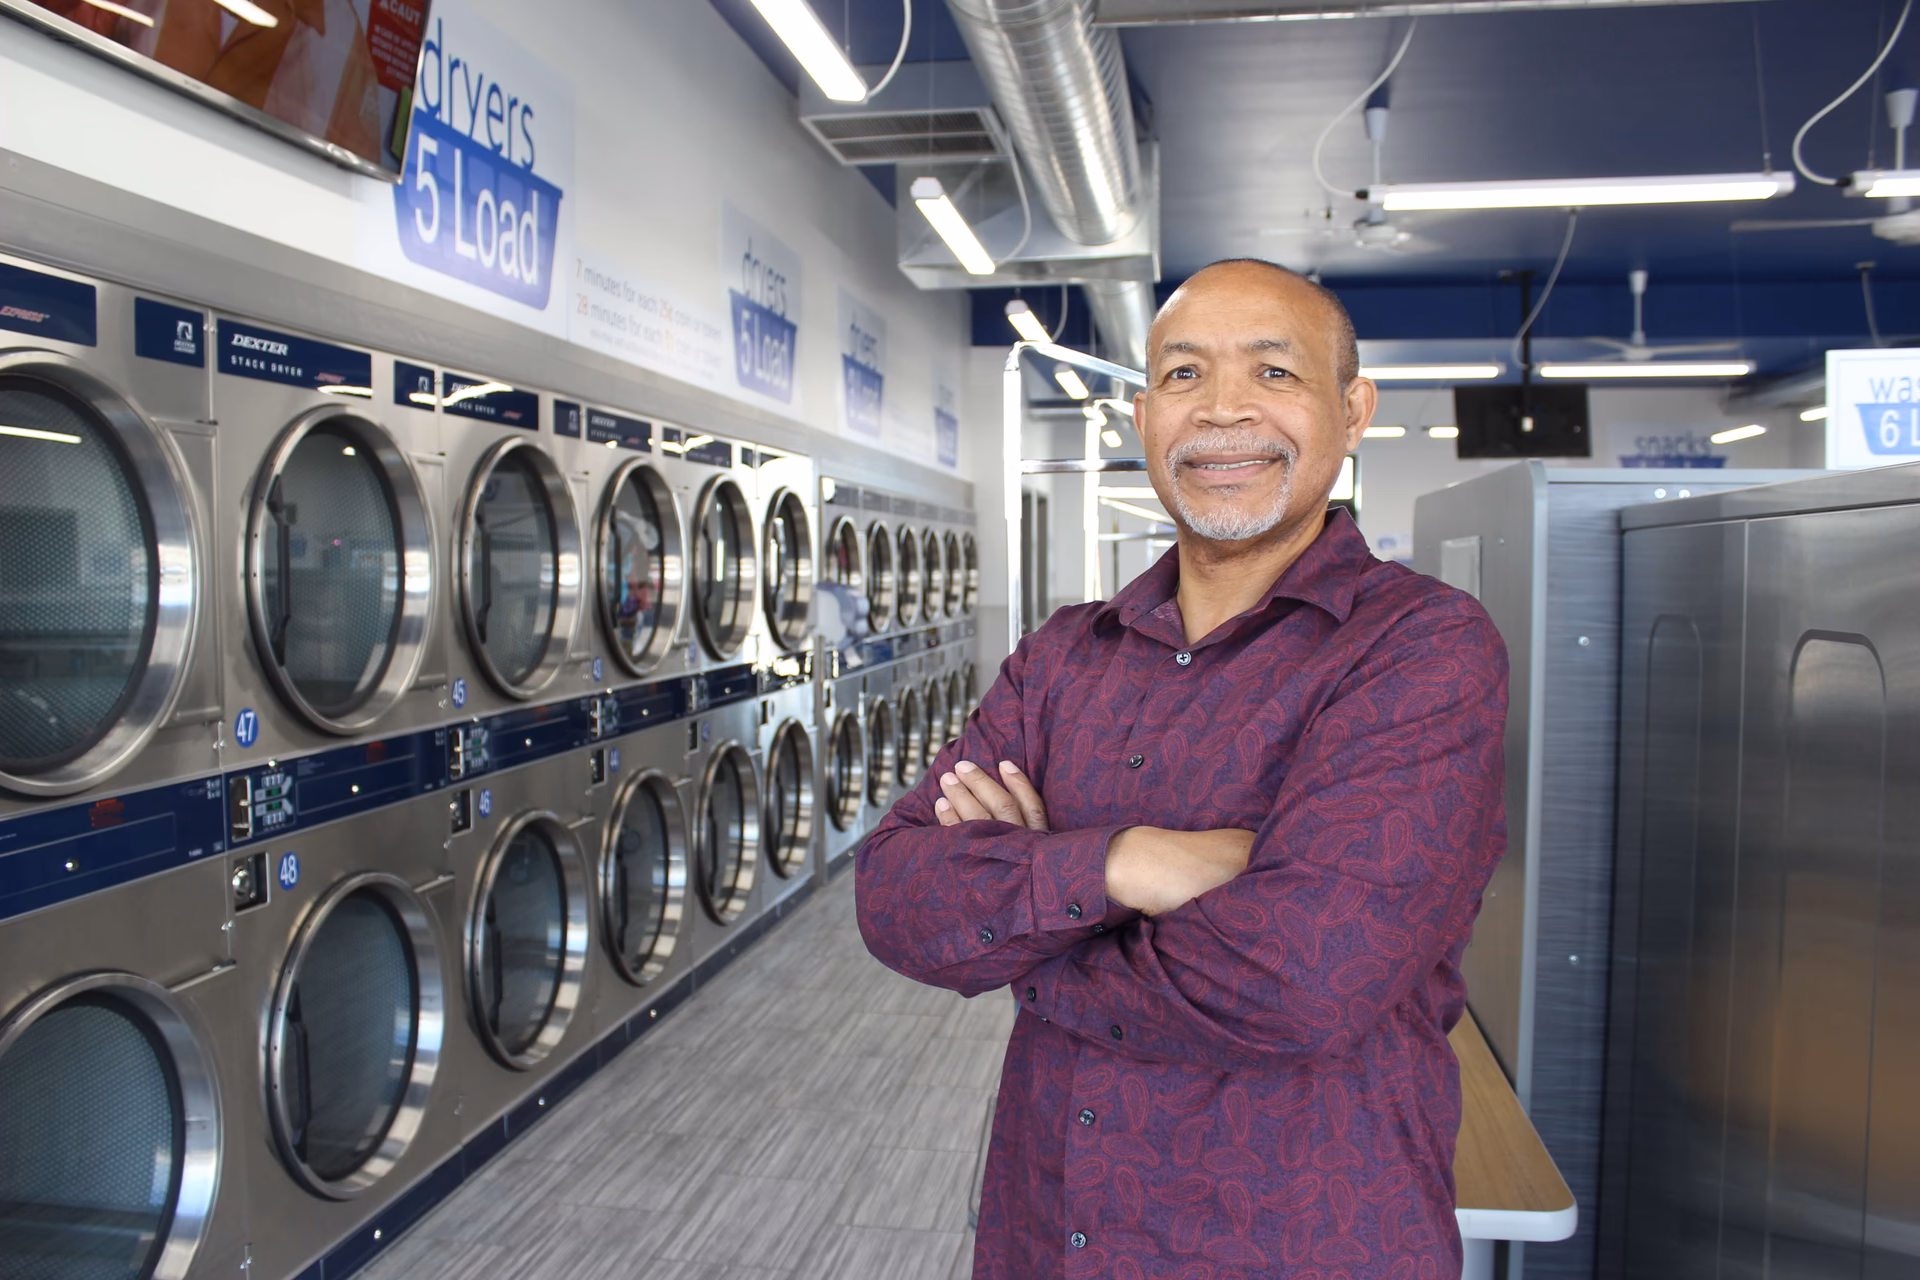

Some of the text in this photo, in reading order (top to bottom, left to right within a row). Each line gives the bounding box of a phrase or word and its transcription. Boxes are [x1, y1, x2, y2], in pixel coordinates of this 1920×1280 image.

[421, 17, 534, 173] dryers
[415, 133, 539, 286] 5 Load
[584, 267, 621, 298] minutes
[623, 280, 636, 302] for
[742, 236, 788, 320] dryers
[590, 303, 627, 332] minutes
[232, 333, 289, 356] DEXTER
[741, 309, 751, 375] 5
[754, 313, 789, 390] Load
[231, 355, 303, 377] STACK DRYER
[1880, 408, 1900, 449] 6
[452, 679, 465, 705] 45
[236, 711, 255, 742] 47
[479, 790, 491, 816] 46
[280, 854, 297, 884] 48
